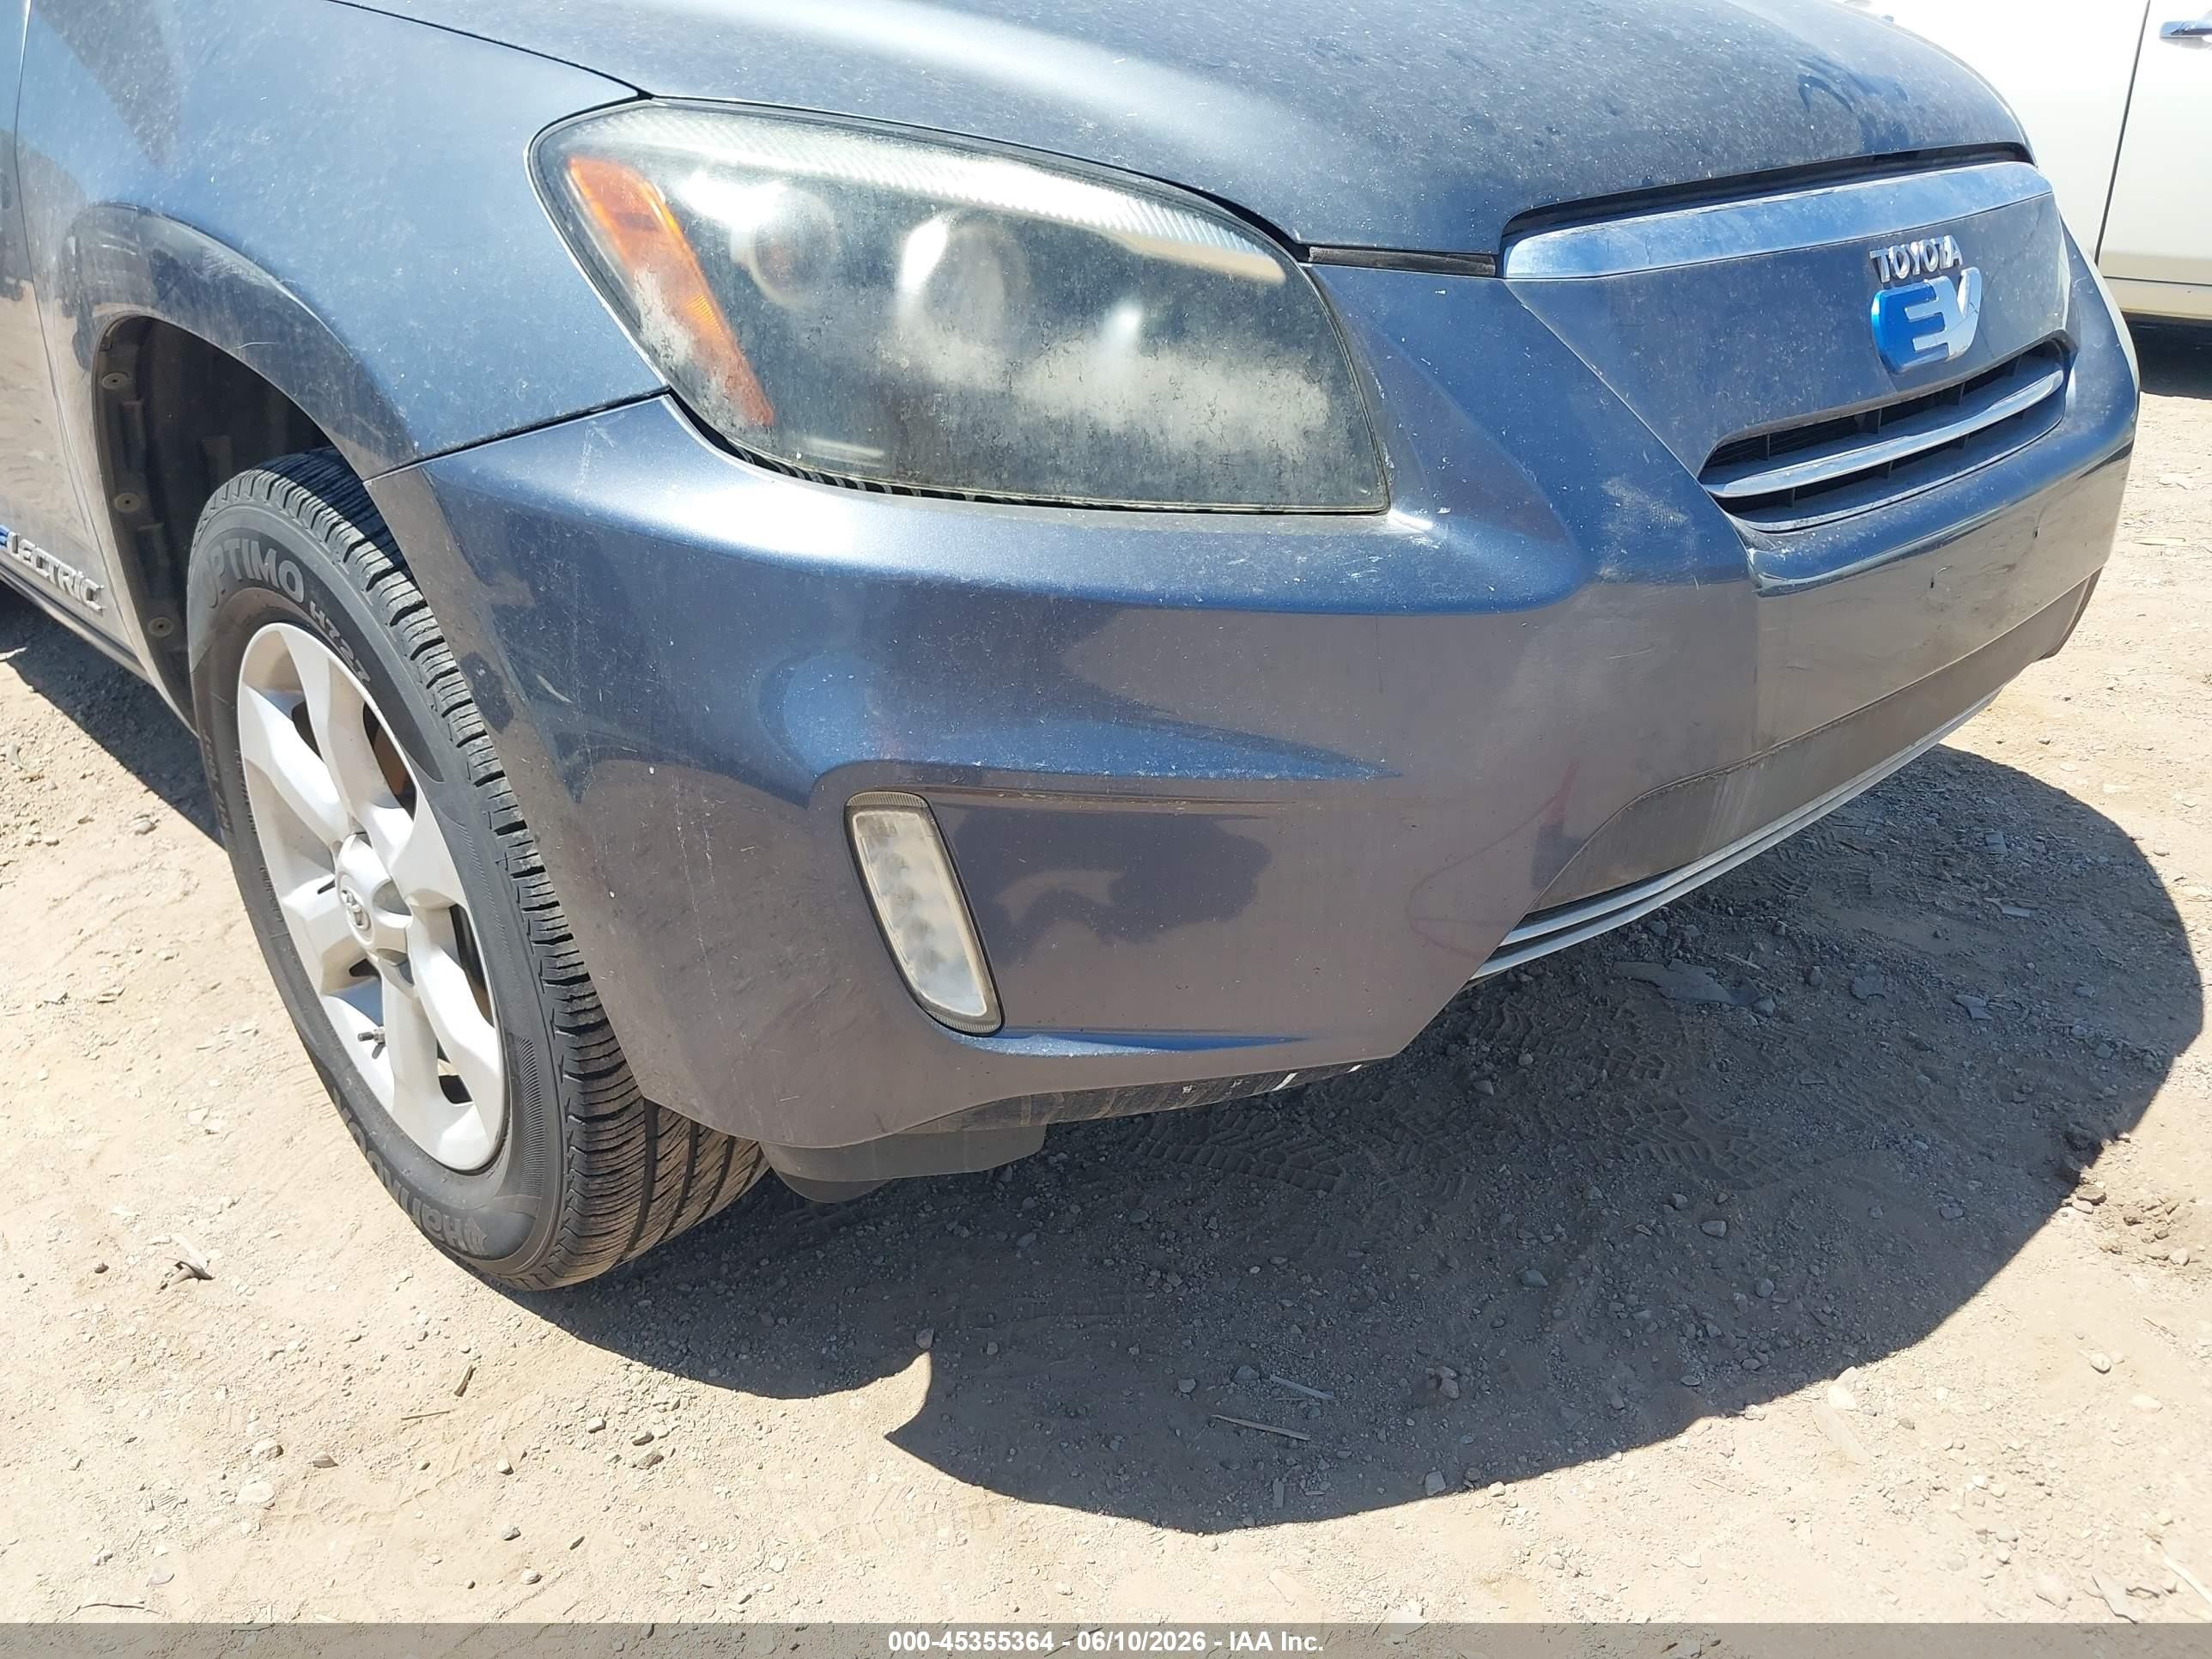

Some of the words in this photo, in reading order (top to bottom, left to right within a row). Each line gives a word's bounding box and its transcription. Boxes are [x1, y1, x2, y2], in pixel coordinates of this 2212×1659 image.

[1869, 234, 1964, 283] TOYOTA
[1871, 266, 1983, 374] EV
[309, 600, 371, 684] H727
